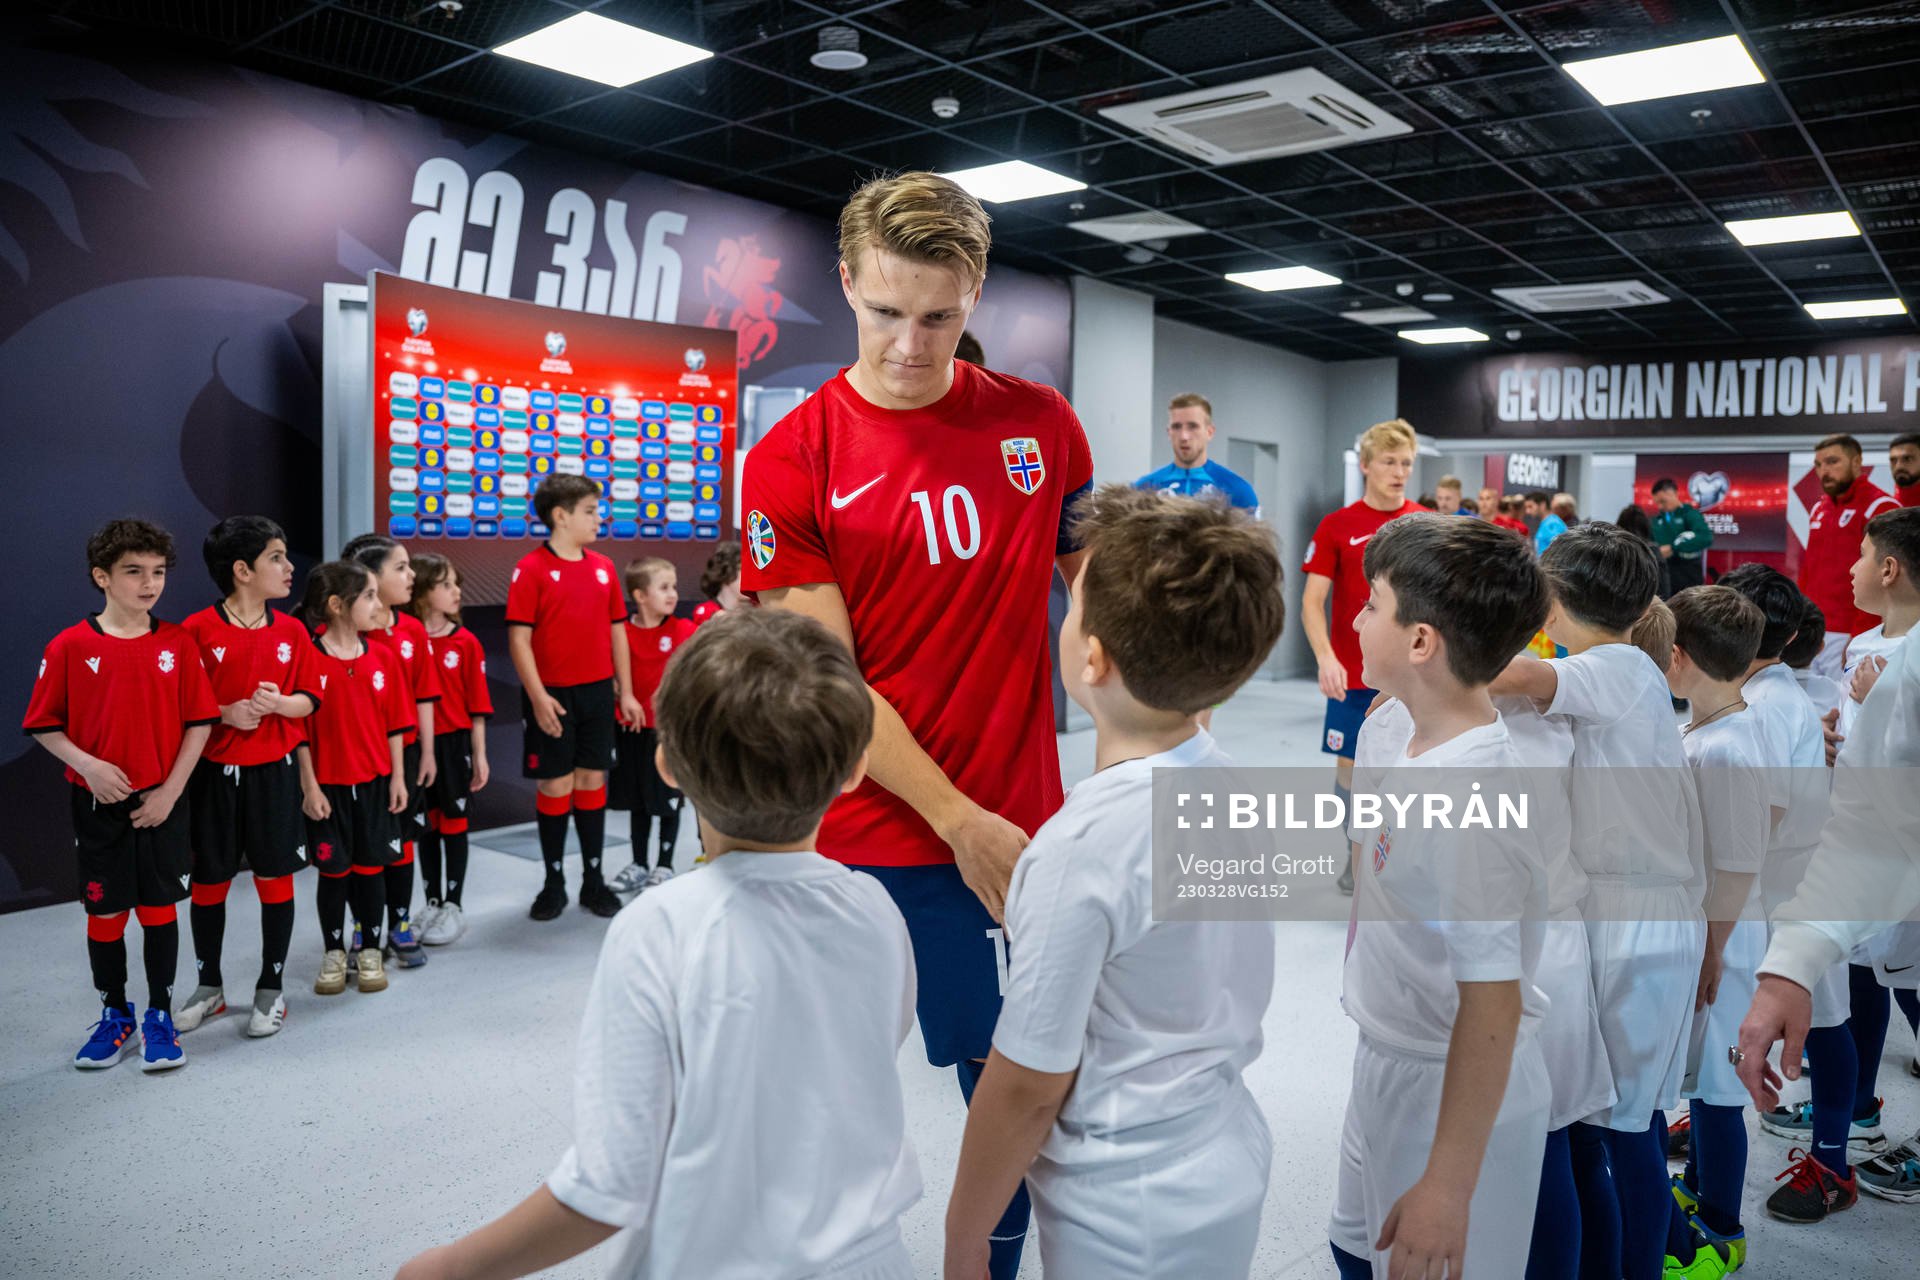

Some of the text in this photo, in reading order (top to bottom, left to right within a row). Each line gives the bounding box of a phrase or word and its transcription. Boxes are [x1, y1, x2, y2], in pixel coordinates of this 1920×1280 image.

[1498, 363, 1674, 422] GEORGIAN
[1686, 353, 1888, 418] NATIONAL
[911, 485, 981, 565] 10
